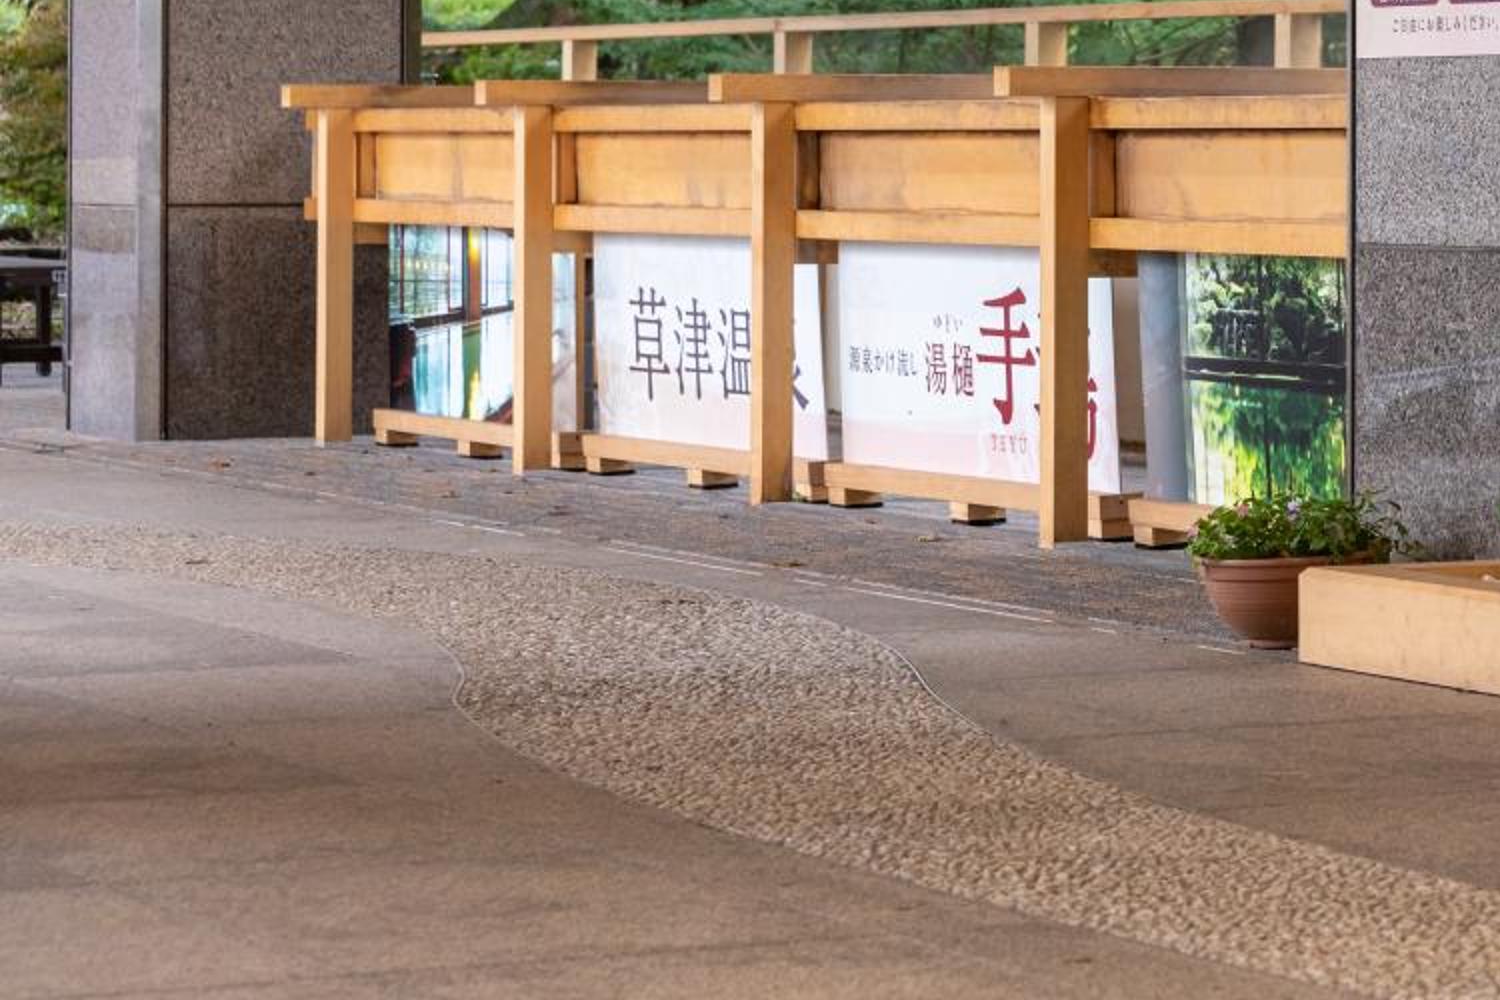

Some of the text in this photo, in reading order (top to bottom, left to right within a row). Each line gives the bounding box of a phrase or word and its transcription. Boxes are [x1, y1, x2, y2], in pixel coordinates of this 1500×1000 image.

[629, 286, 810, 411] 草津温
[847, 346, 918, 377] 源泉かけ流し
[924, 341, 975, 397] 湯樋
